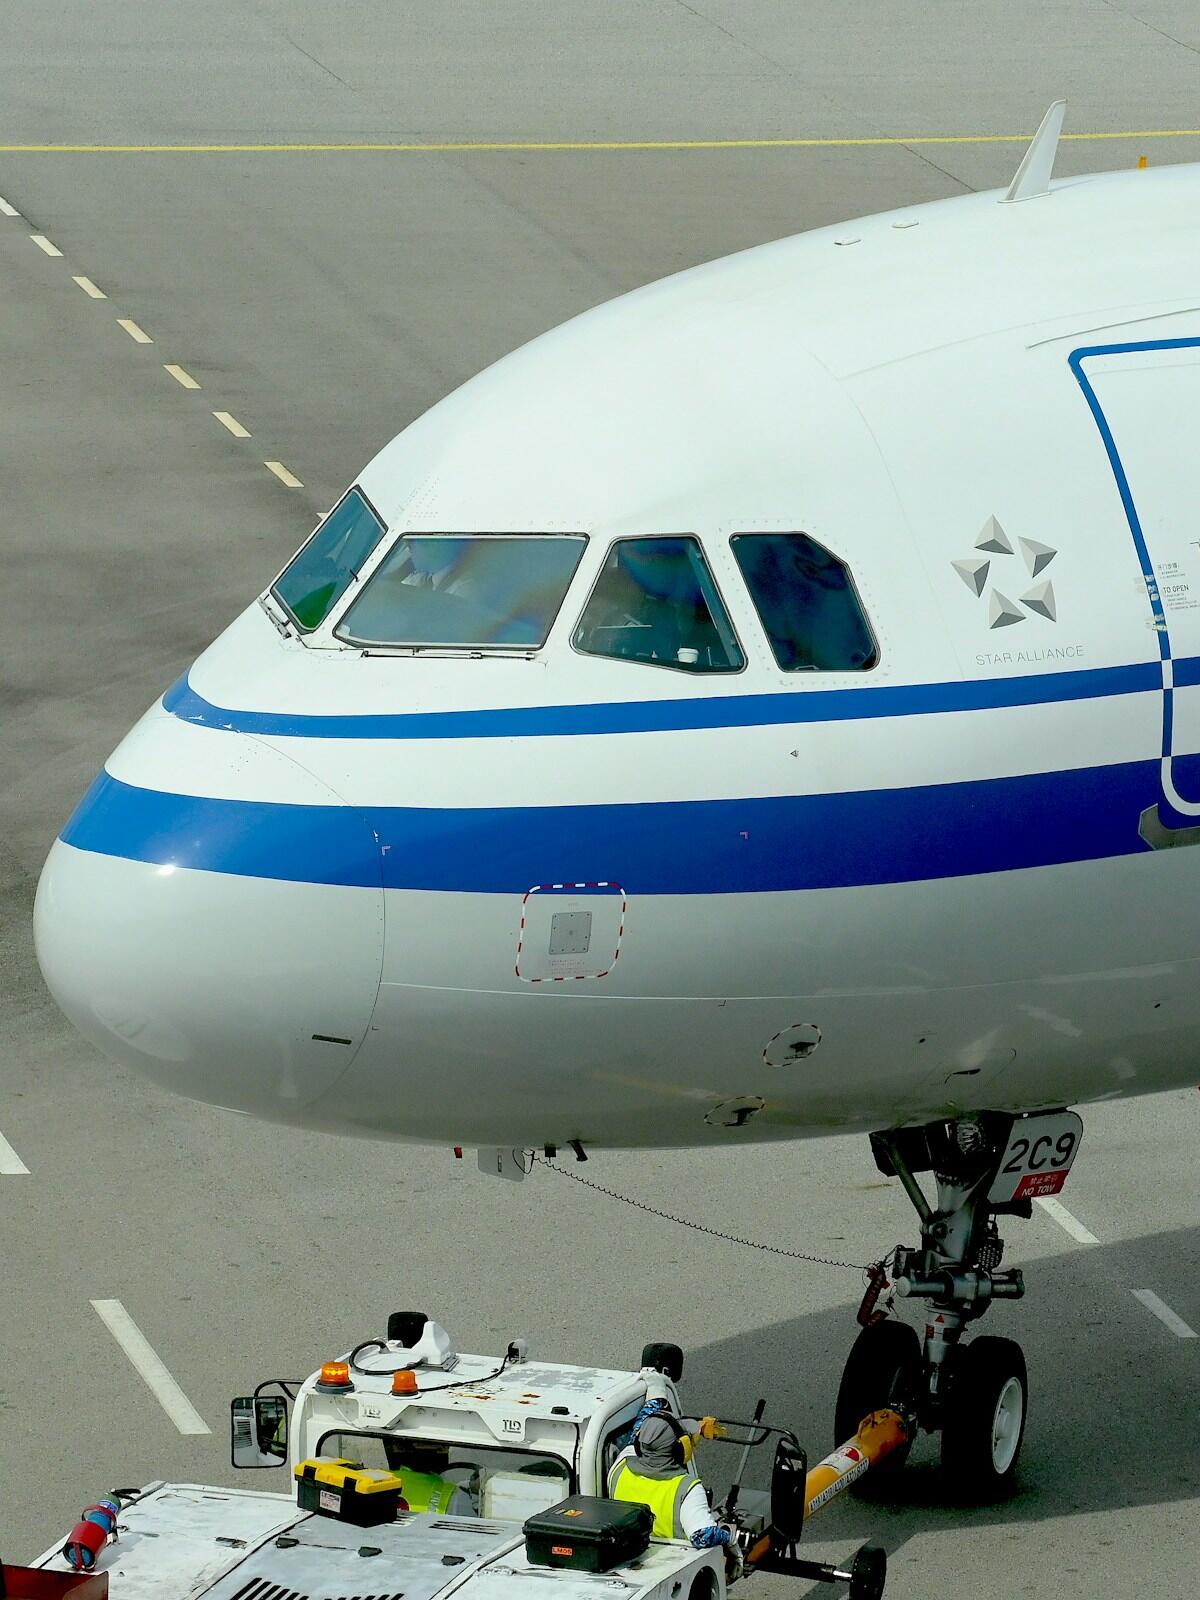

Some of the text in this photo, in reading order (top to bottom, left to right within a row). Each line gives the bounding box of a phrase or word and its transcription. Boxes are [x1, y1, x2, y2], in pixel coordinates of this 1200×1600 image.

[1163, 584, 1189, 594] TO OPEN
[975, 645, 1085, 666] STAR ALLIANCE
[1001, 1132, 1076, 1174] 2C9
[1021, 1184, 1055, 1197] NO TOW
[502, 1419, 522, 1431] TLD
